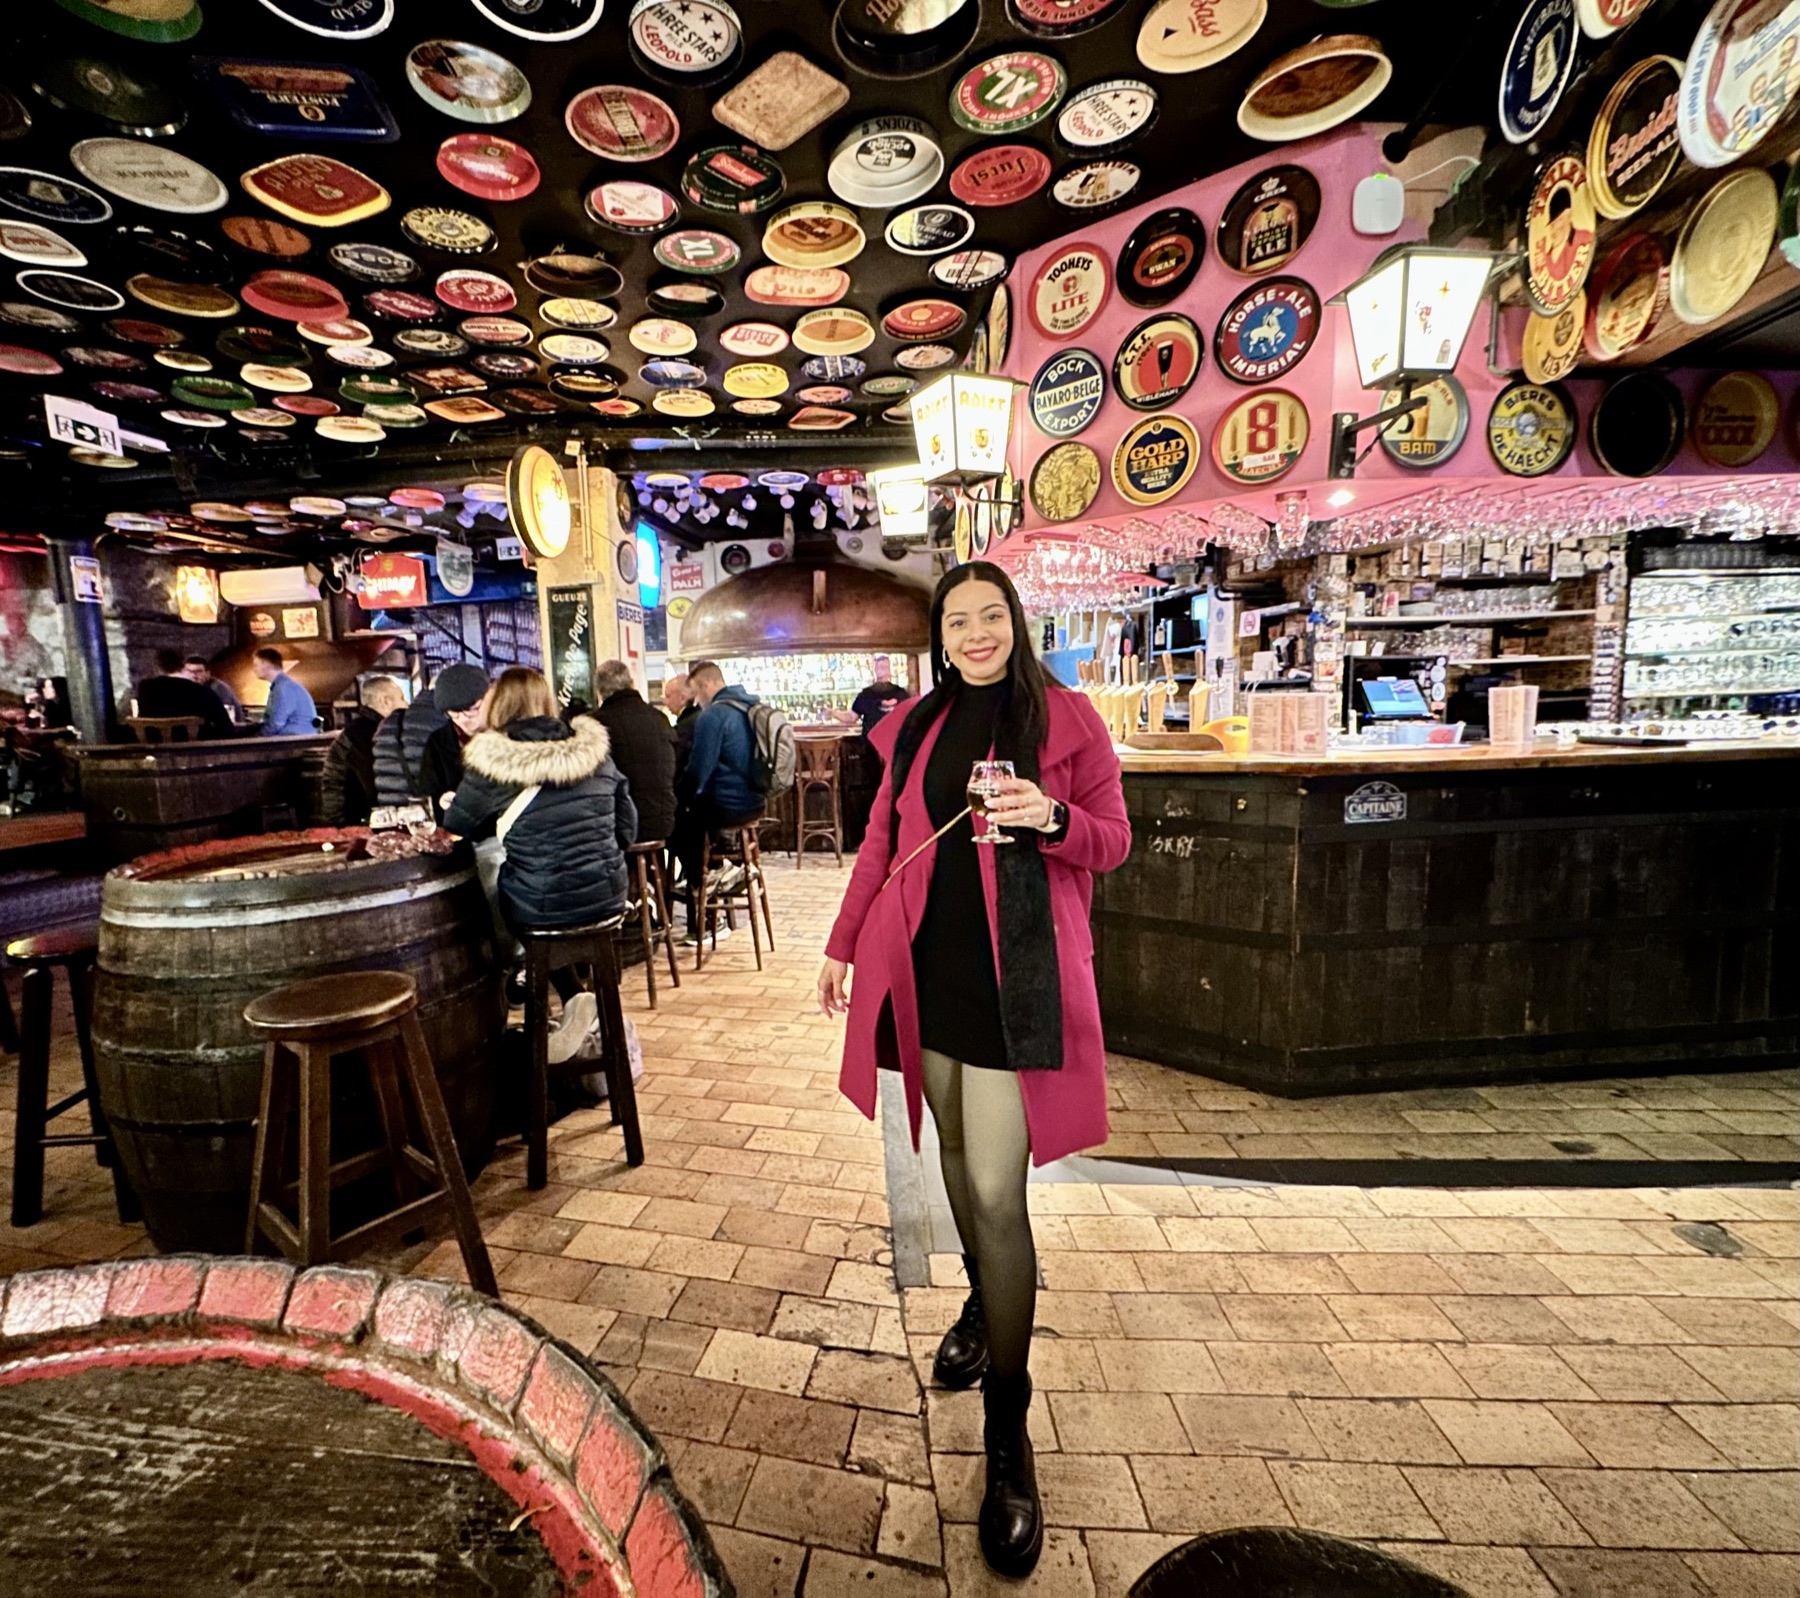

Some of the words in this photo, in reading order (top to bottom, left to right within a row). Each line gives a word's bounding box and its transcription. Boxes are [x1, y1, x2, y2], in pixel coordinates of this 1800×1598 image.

[645, 24, 692, 63] LEOPOLD
[650, 3, 687, 35] THREE
[683, 31, 722, 63] STARS
[985, 69, 1039, 109] XL
[876, 116, 923, 134] SEZOENS
[1073, 110, 1104, 138] LEOPOLD
[1102, 112, 1131, 136] STARS
[679, 238, 715, 260] XL
[1252, 237, 1288, 261] ALE
[1047, 256, 1094, 284] TOOHEYS
[1148, 258, 1177, 275] SWAN
[1536, 243, 1591, 301] BITTER
[1051, 292, 1090, 315] LITE
[1228, 288, 1313, 333] HORSE-ALE
[1124, 333, 1151, 367] C.T.S.
[1229, 340, 1307, 377] IMPERIAL
[1047, 358, 1086, 384] BOCK
[1035, 377, 1101, 411] BAVARO-BELGE
[1506, 389, 1556, 412] BIERES
[1043, 400, 1094, 431] EXPORT
[1246, 398, 1280, 454] 8
[1130, 438, 1186, 460] GOLD
[1399, 441, 1438, 455] BAM
[1493, 433, 1504, 454] DE
[1505, 433, 1560, 468] HAECHT
[1130, 450, 1186, 474] HARP
[551, 592, 588, 603] GUEUZE
[568, 602, 589, 645] Page
[617, 605, 643, 625] BIERES
[1348, 800, 1403, 816] CAPITAINE
